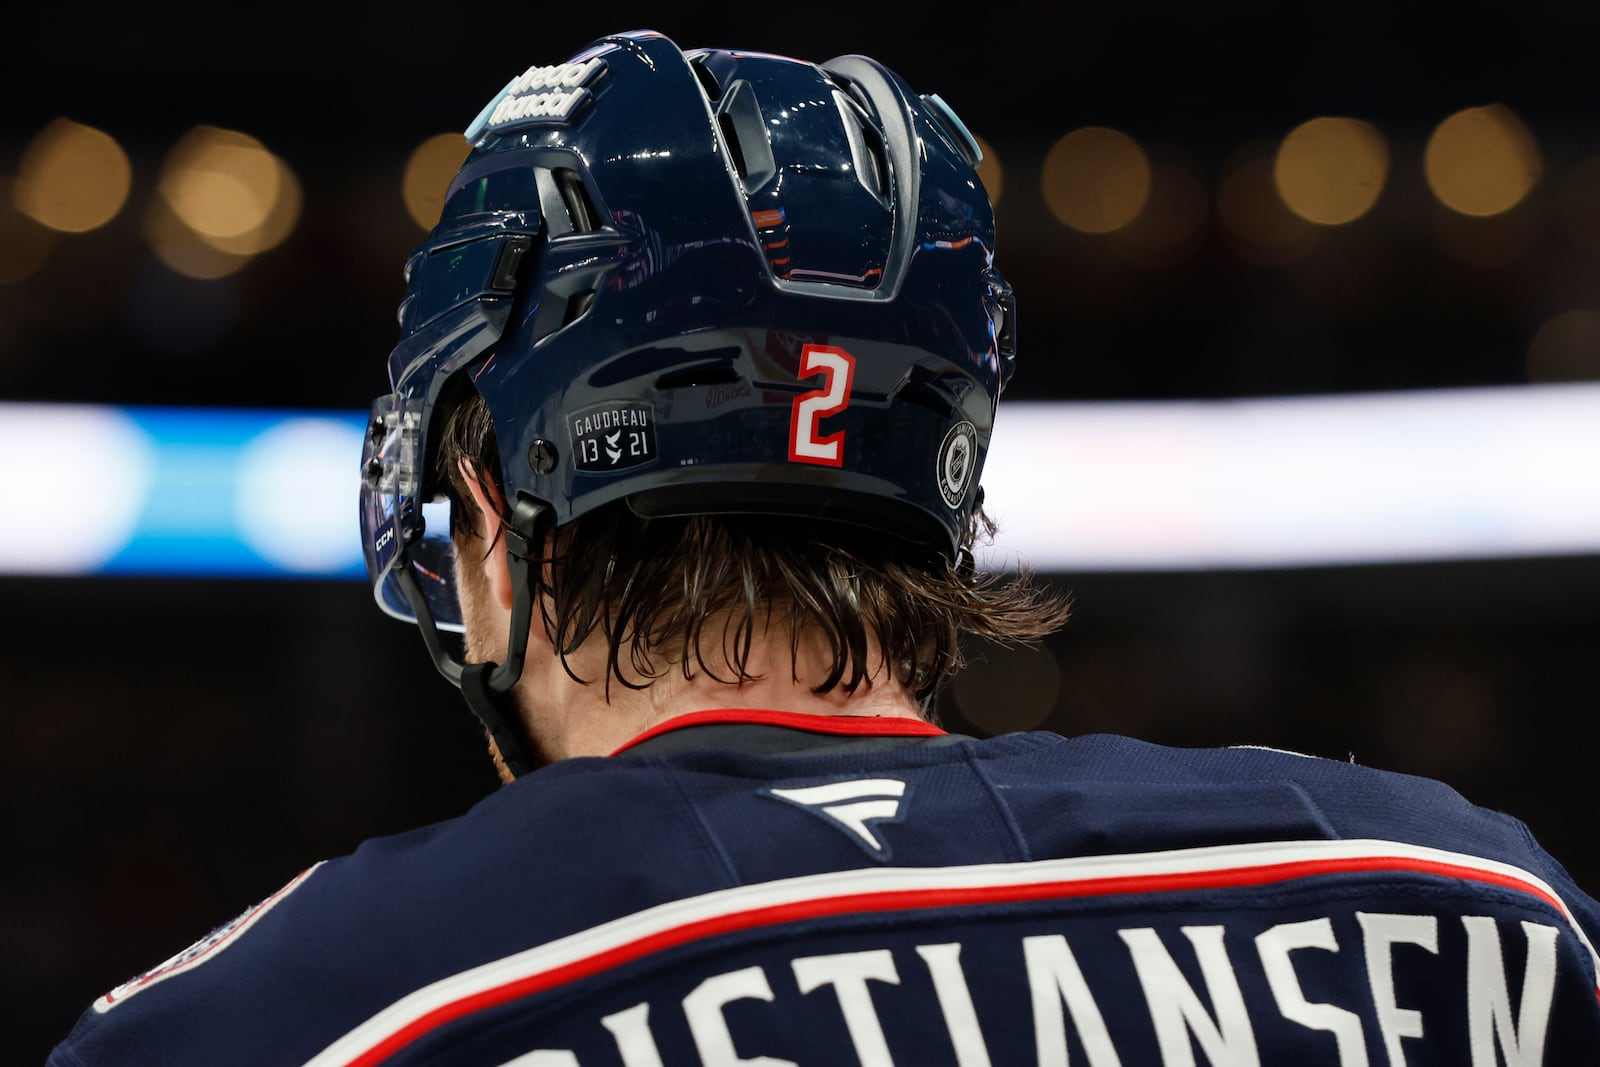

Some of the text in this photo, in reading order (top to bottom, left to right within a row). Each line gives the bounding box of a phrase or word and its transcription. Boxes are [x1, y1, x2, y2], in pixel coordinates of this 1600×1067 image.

[509, 57, 602, 96] read
[787, 343, 857, 468] 2
[575, 409, 647, 437] GAUDREAU
[580, 431, 648, 463] 13 21
[941, 478, 964, 505] EQUALITY
[376, 527, 393, 551] CCM
[497, 911, 1560, 1067] STIANSEN
